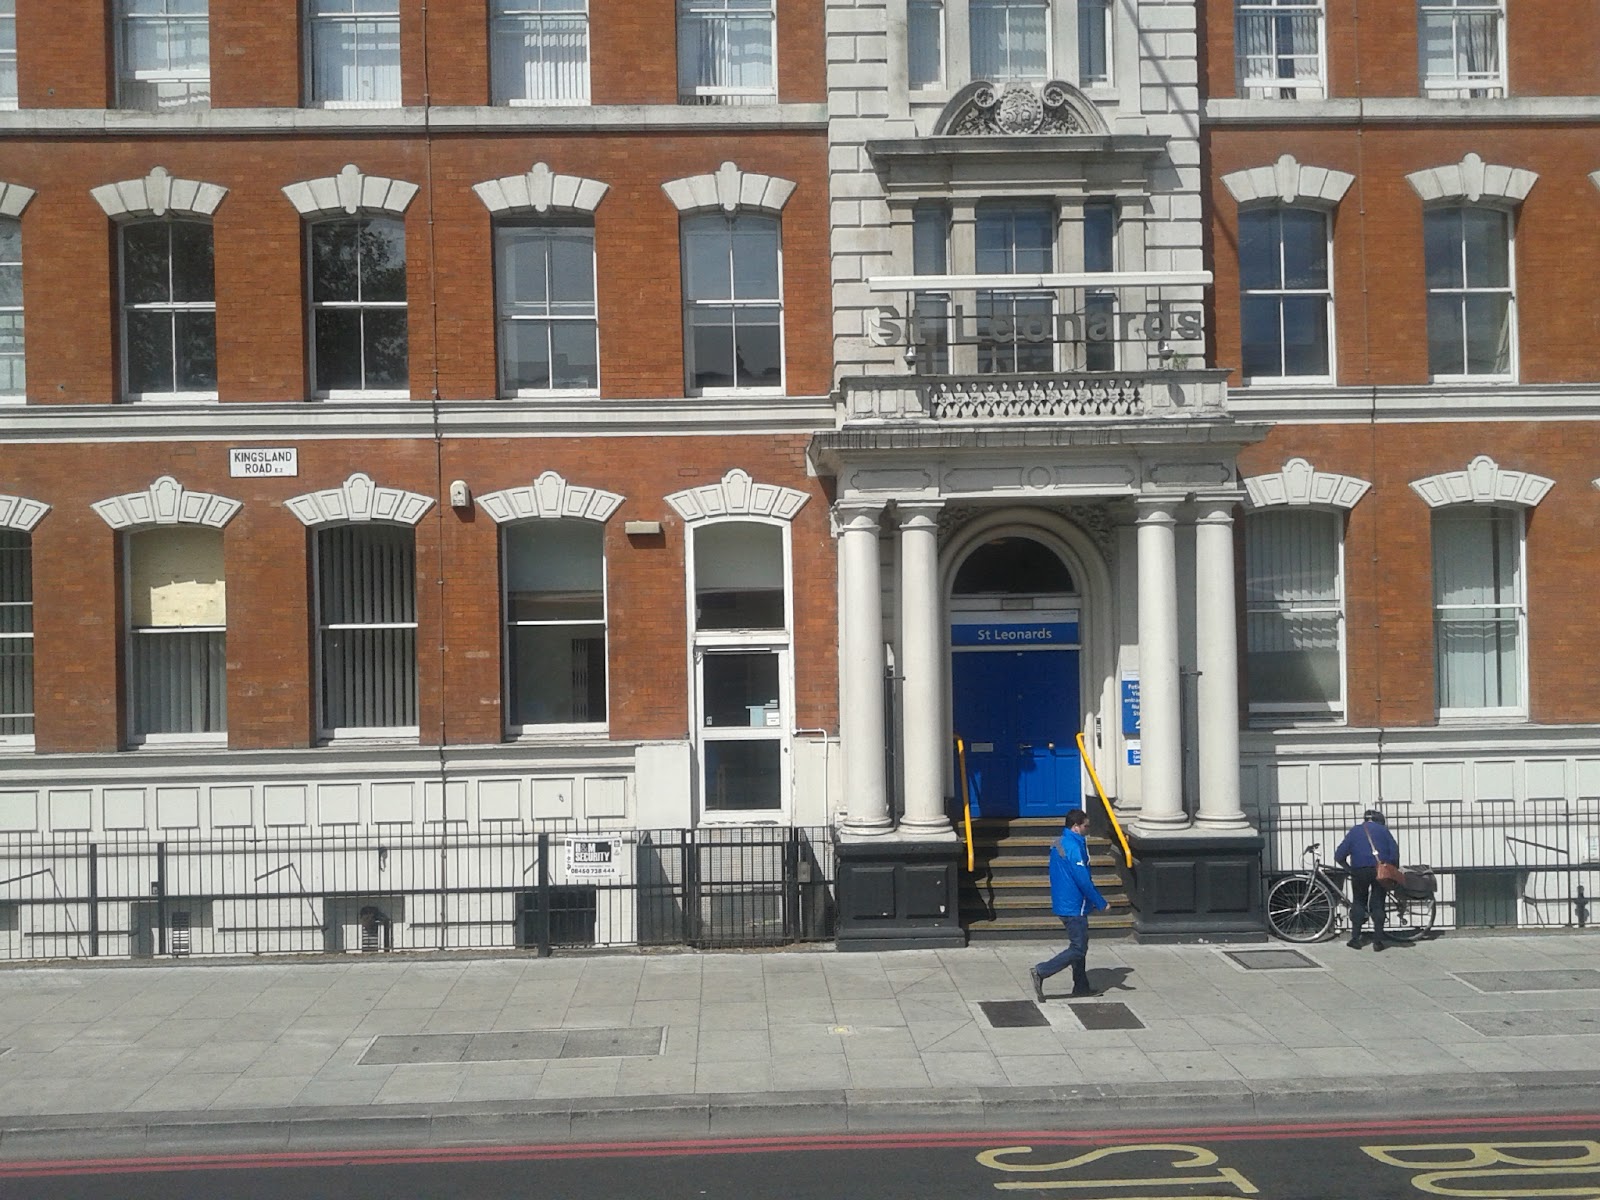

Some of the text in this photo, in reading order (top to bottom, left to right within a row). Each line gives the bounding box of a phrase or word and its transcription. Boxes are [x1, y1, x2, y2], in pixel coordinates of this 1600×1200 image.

[869, 302, 1202, 346] St Leonards
[234, 451, 292, 462] KINGSLAND
[245, 463, 272, 473] ROAD
[977, 627, 1052, 640] St Leonards
[575, 852, 610, 862] SECURITY
[975, 1143, 1260, 1200] ST
[1359, 1140, 1600, 1200] BU
